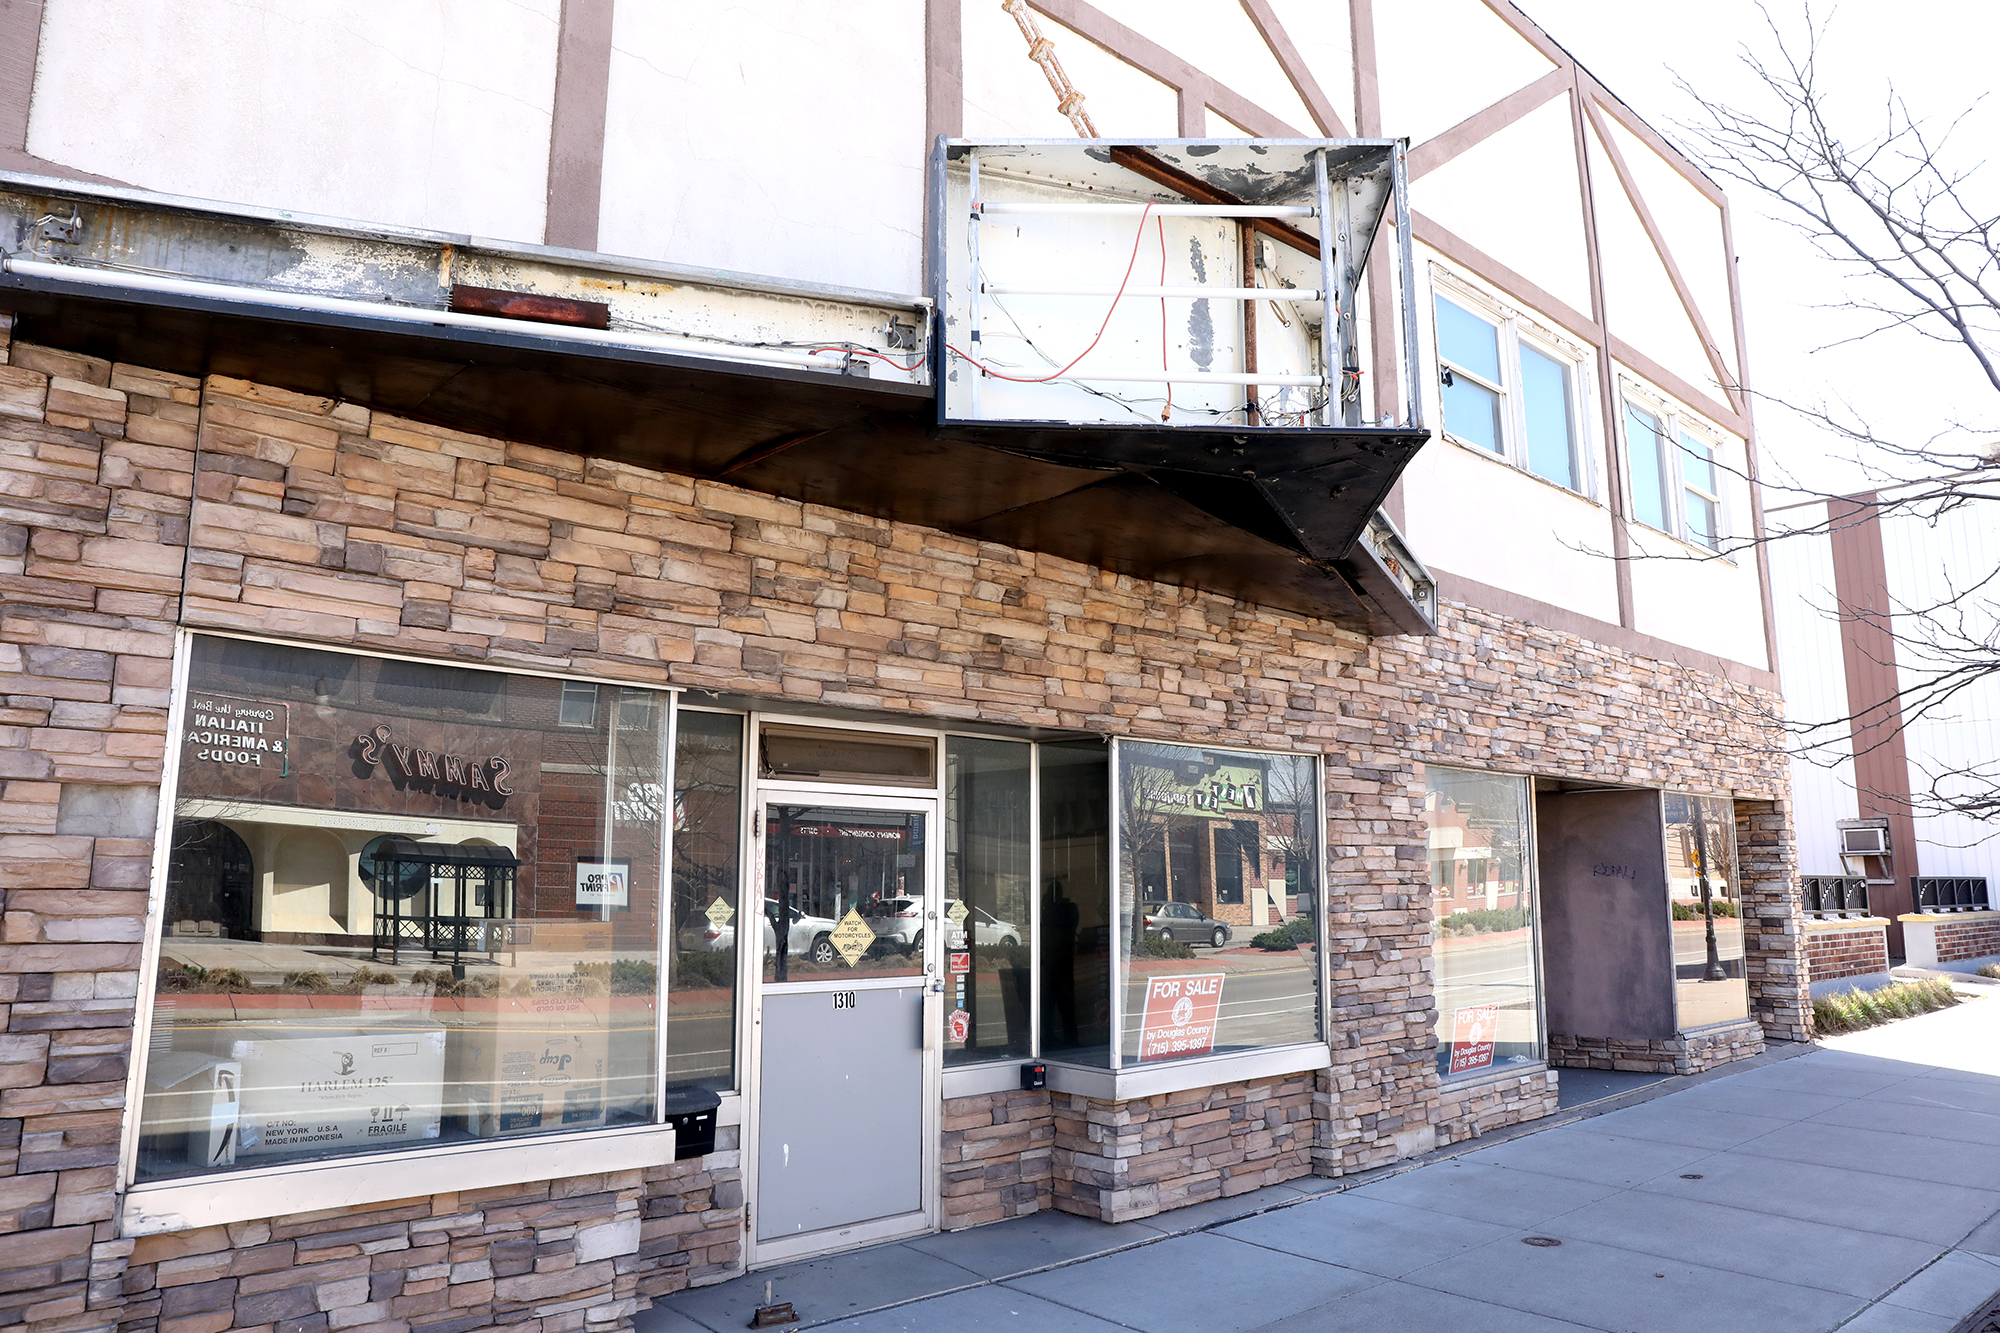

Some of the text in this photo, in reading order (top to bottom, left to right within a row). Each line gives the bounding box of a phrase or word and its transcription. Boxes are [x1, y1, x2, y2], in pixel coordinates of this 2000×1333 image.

[951, 931, 968, 939] ATM
[1153, 979, 1218, 998] FOR SALE
[833, 992, 855, 1009] 1310
[1458, 1007, 1498, 1024] FOR SALE
[1146, 1025, 1211, 1042] by Douglas County
[1148, 1037, 1207, 1056] (715) 395-1397
[1454, 1043, 1492, 1058] by Douglas County
[301, 1078, 363, 1092] HARLEM
[368, 1123, 407, 1134] FRAGILE
[300, 1133, 343, 1142] INDONESIA
